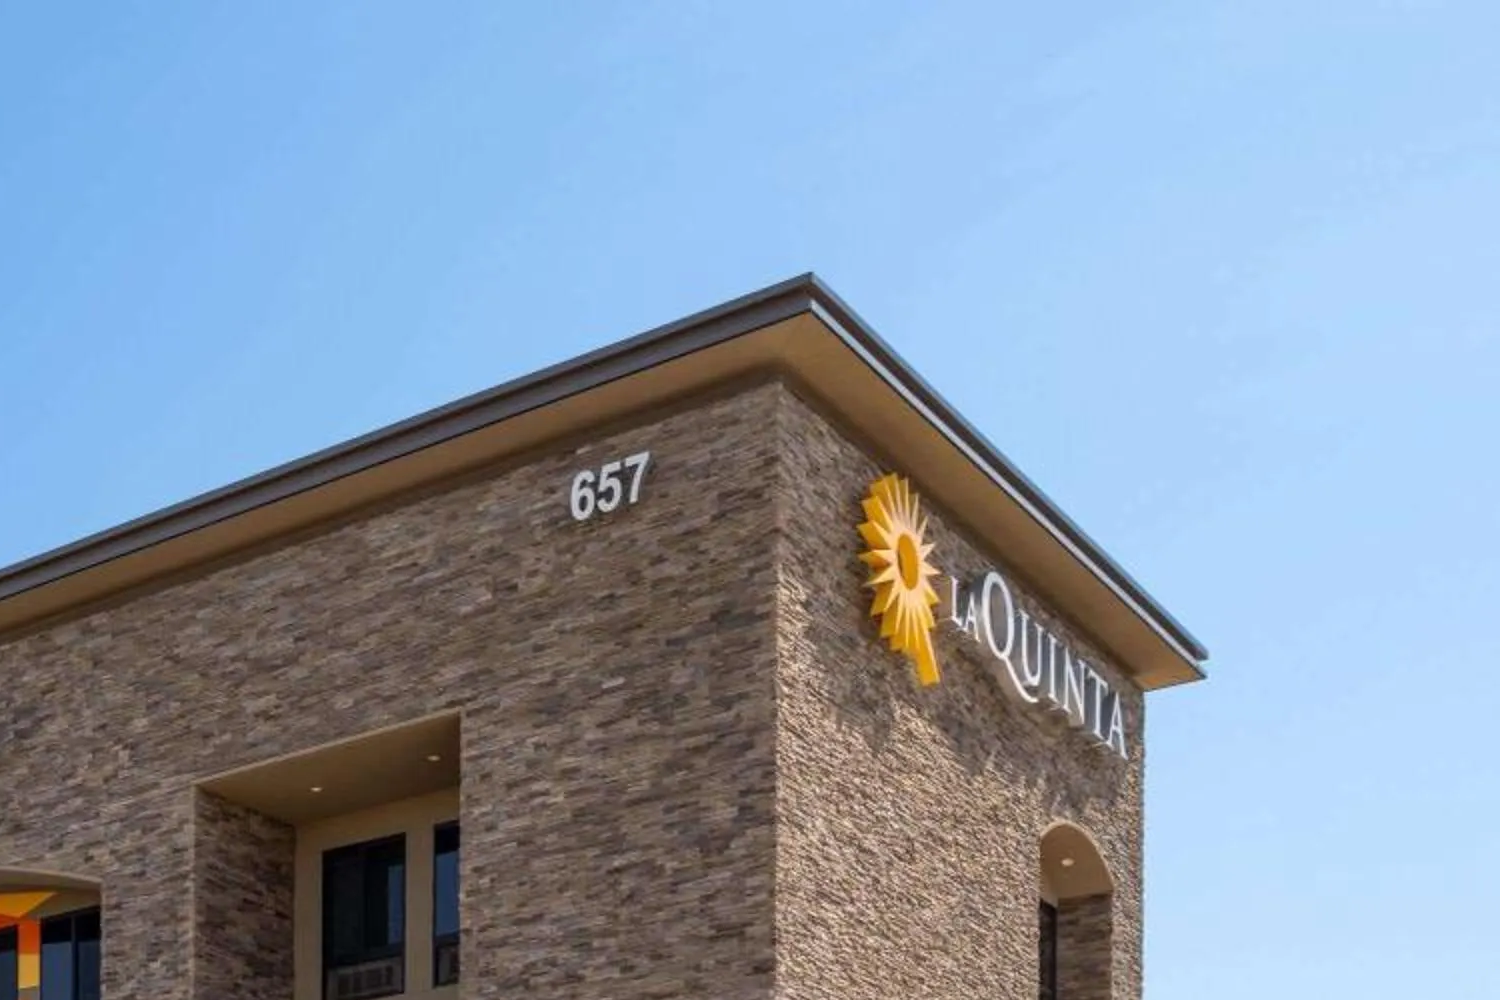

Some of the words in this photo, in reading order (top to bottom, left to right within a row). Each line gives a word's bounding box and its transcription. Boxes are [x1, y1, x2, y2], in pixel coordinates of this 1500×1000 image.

[570, 451, 650, 521] 657
[949, 575, 981, 643] LA
[982, 571, 1128, 760] QUINTA
